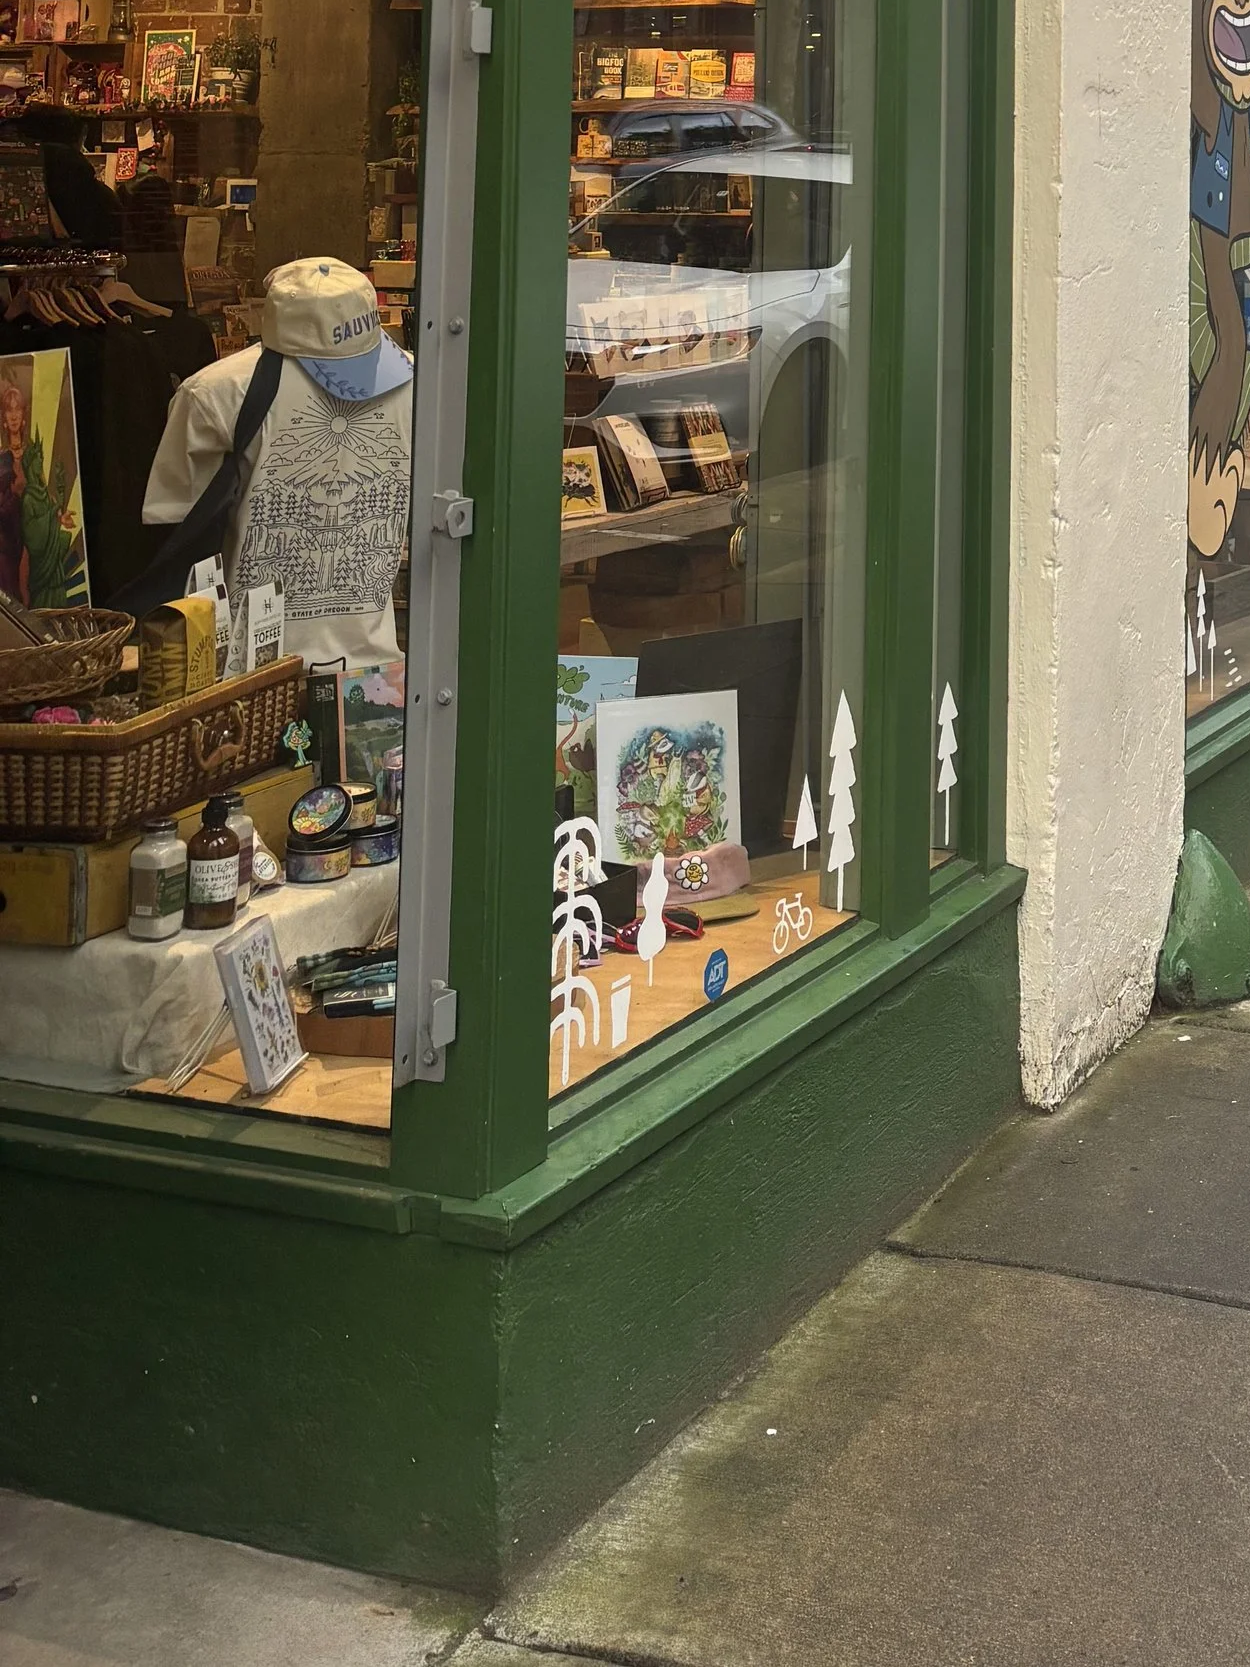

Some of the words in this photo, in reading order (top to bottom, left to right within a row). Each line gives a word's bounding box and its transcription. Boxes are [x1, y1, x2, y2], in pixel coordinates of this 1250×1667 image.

[254, 626, 281, 646] TOFFEE
[194, 864, 222, 875] OLIVE
[708, 960, 727, 986] ADT
